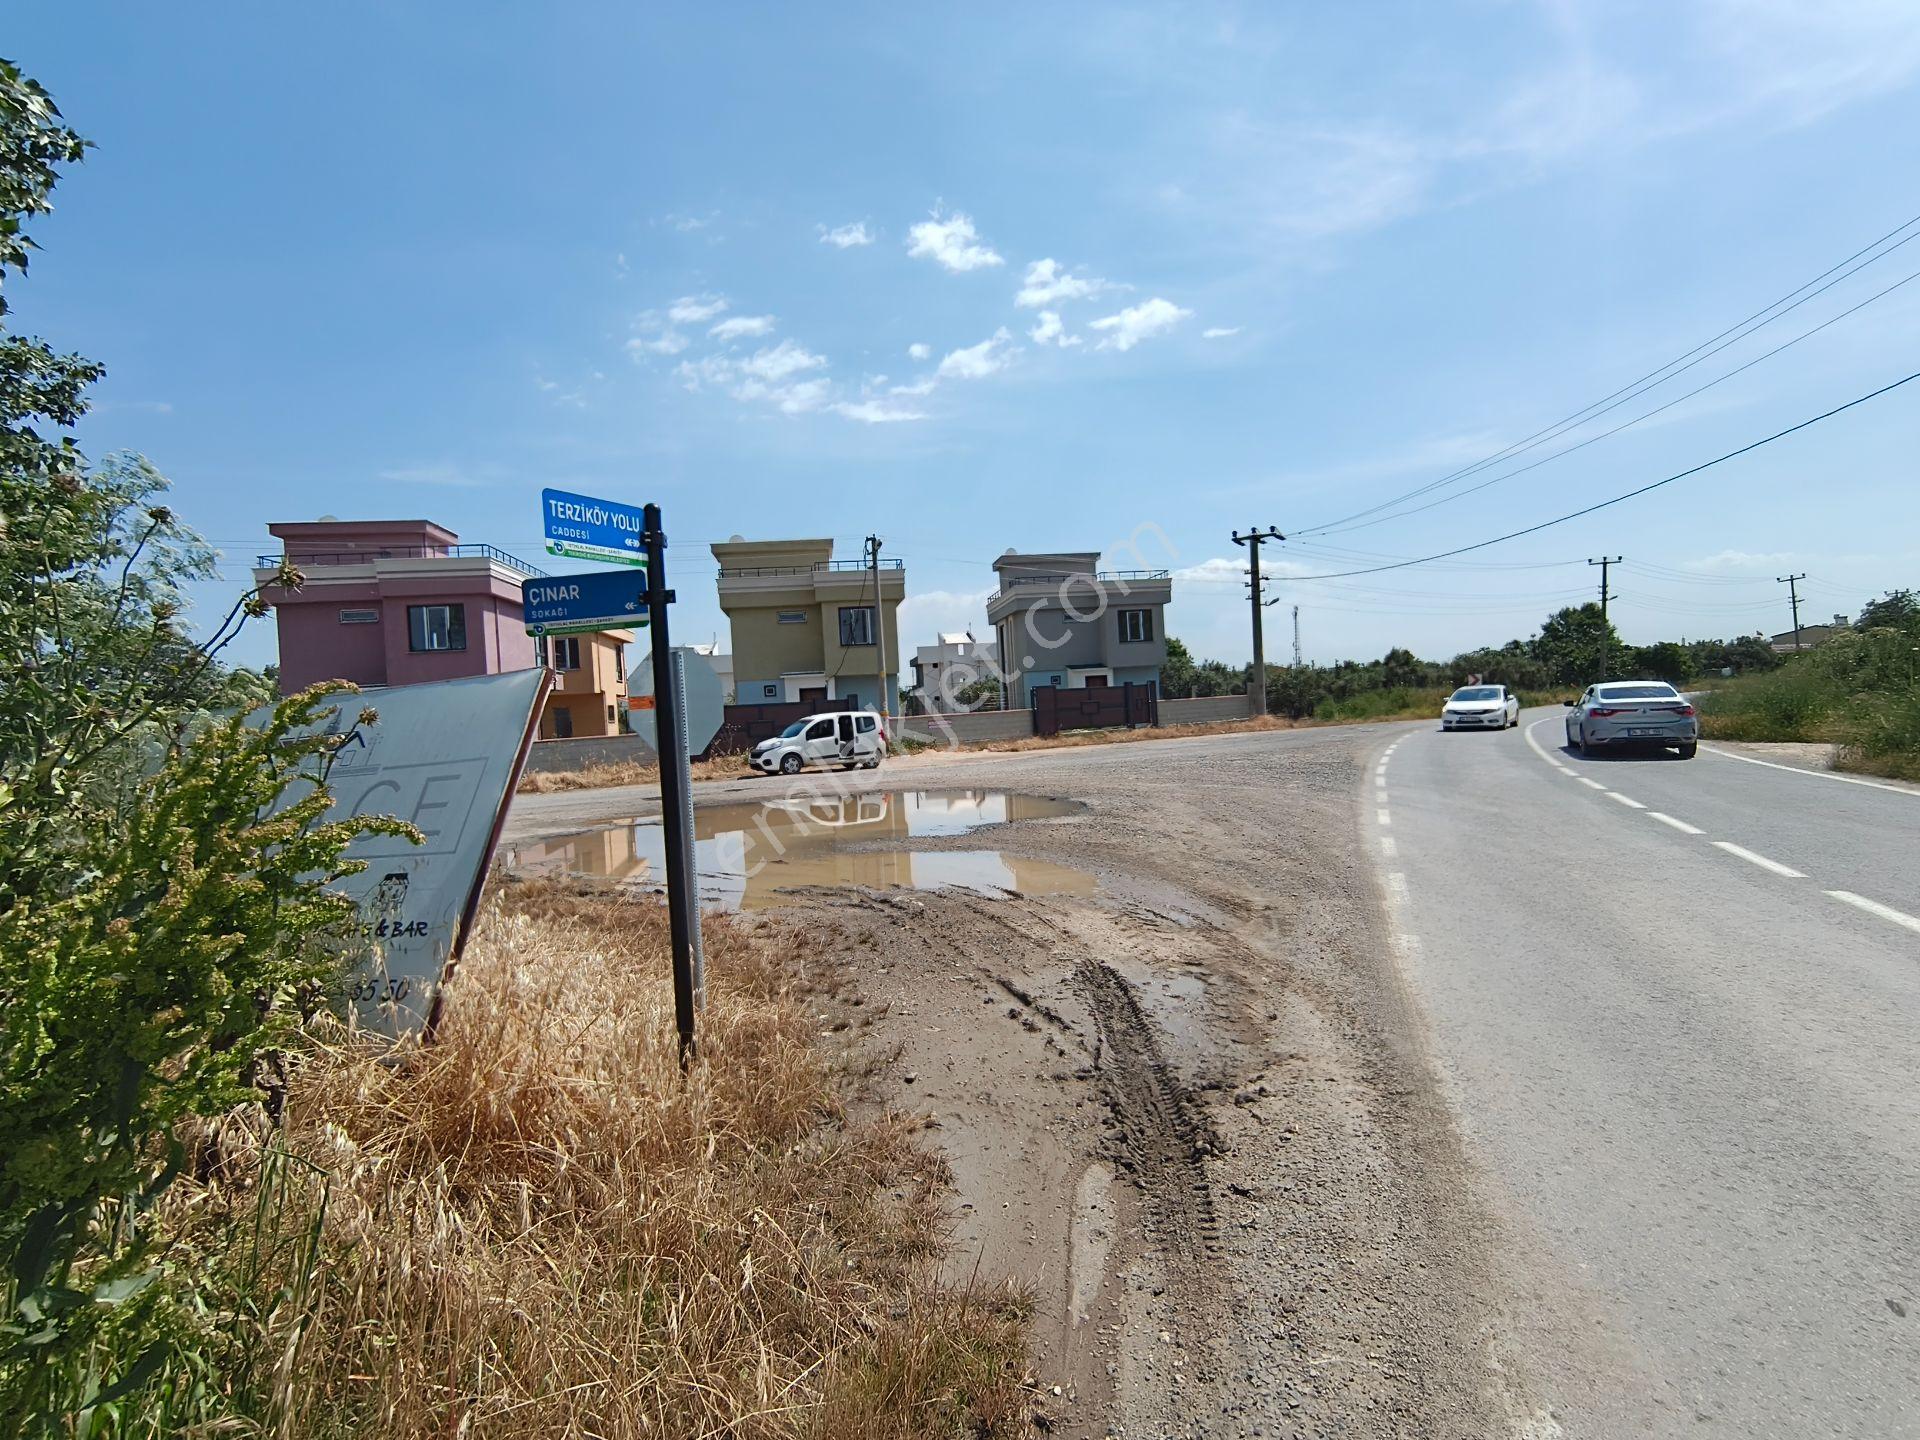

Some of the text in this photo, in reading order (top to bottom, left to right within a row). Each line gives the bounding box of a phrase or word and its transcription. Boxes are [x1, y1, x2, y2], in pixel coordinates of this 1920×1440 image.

[549, 499, 640, 533] TERZİKÖY YOLU
[551, 525, 590, 540] CADDESİ
[529, 584, 580, 606] ÇINAR
[531, 607, 568, 619] SOKAĞI
[391, 920, 428, 938] BAR
